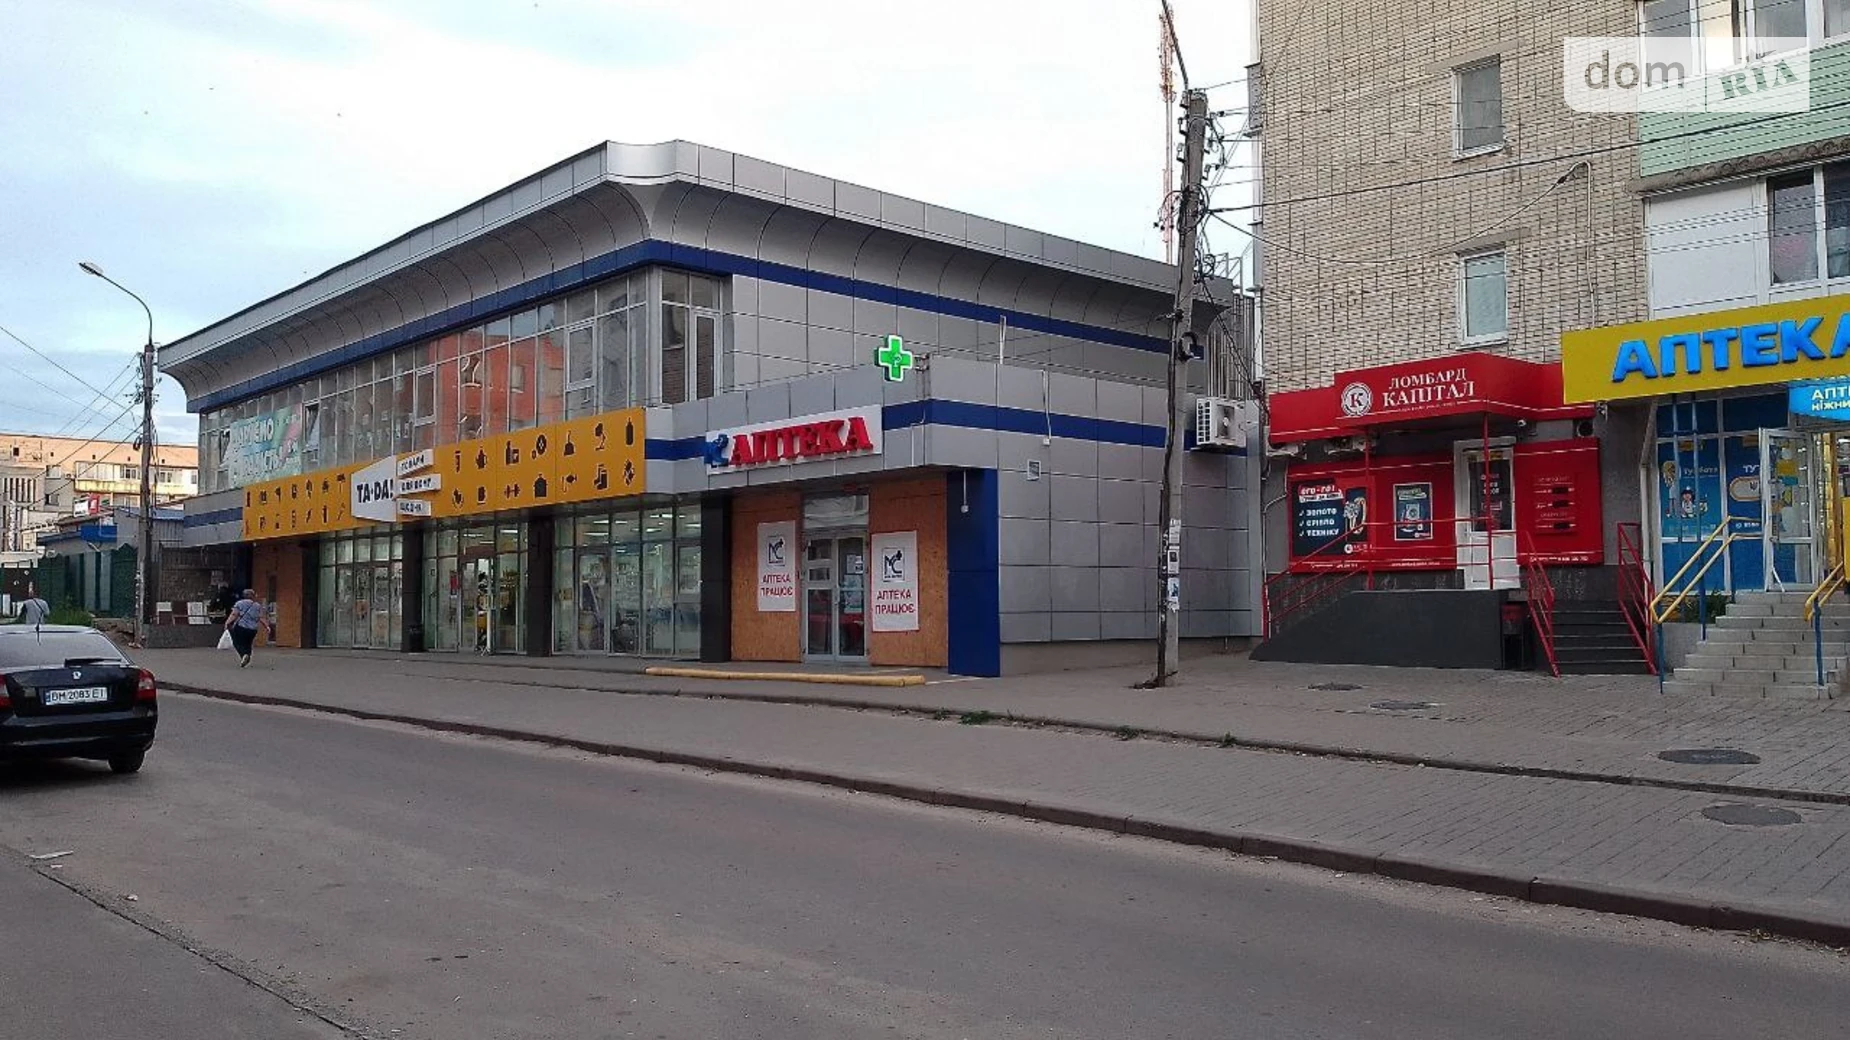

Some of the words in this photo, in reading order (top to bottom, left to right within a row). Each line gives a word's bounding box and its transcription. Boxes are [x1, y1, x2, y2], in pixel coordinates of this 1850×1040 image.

[1389, 368, 1466, 389] ЛОМБАРД
[1382, 381, 1475, 407] КАПІТАЛ
[1812, 385, 1850, 400] АПТ
[729, 416, 873, 466] АПТЕКА
[1306, 507, 1337, 517] ЗОЛОТО
[1306, 518, 1335, 527] СРІБЛО
[1306, 528, 1340, 537] ТЕХНІКУ
[763, 573, 791, 584] АПТЕКА
[760, 586, 793, 597] ПРАЦЮЄ
[877, 589, 912, 601] АПТЕКА
[875, 603, 915, 615] ПРАЦЮЄ
